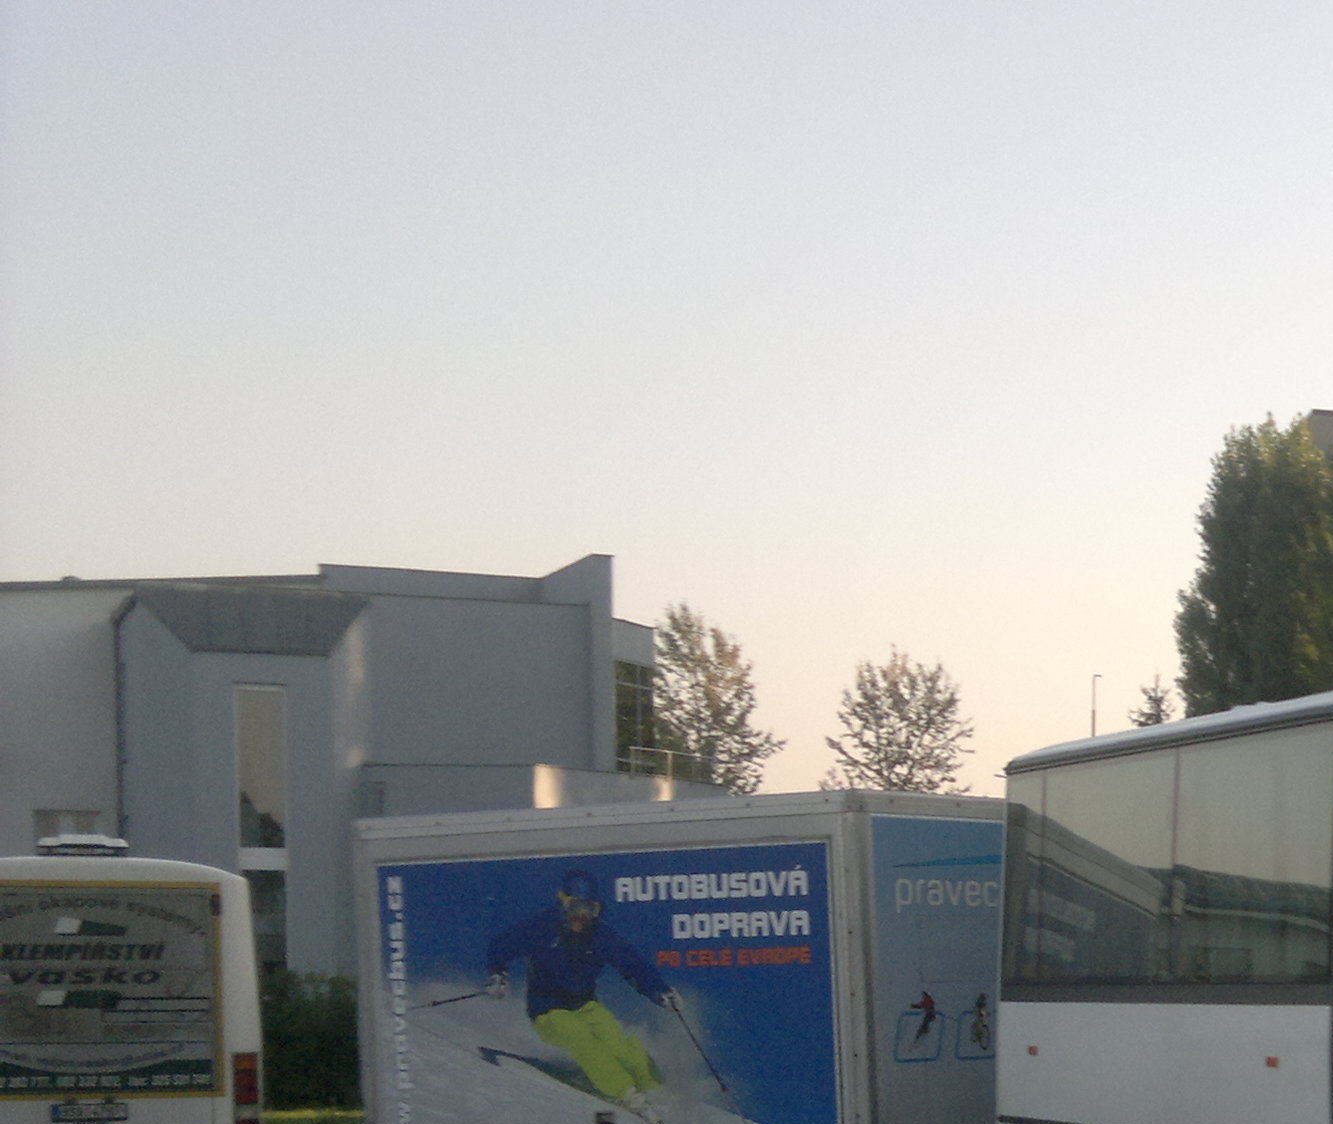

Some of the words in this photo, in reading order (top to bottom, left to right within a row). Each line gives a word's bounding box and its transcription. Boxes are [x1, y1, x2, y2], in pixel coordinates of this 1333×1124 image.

[615, 865, 809, 902] AUTOBUSOVÁ
[896, 877, 1000, 915] pravec
[672, 910, 810, 939] DOPRAVA
[656, 950, 682, 967] PO
